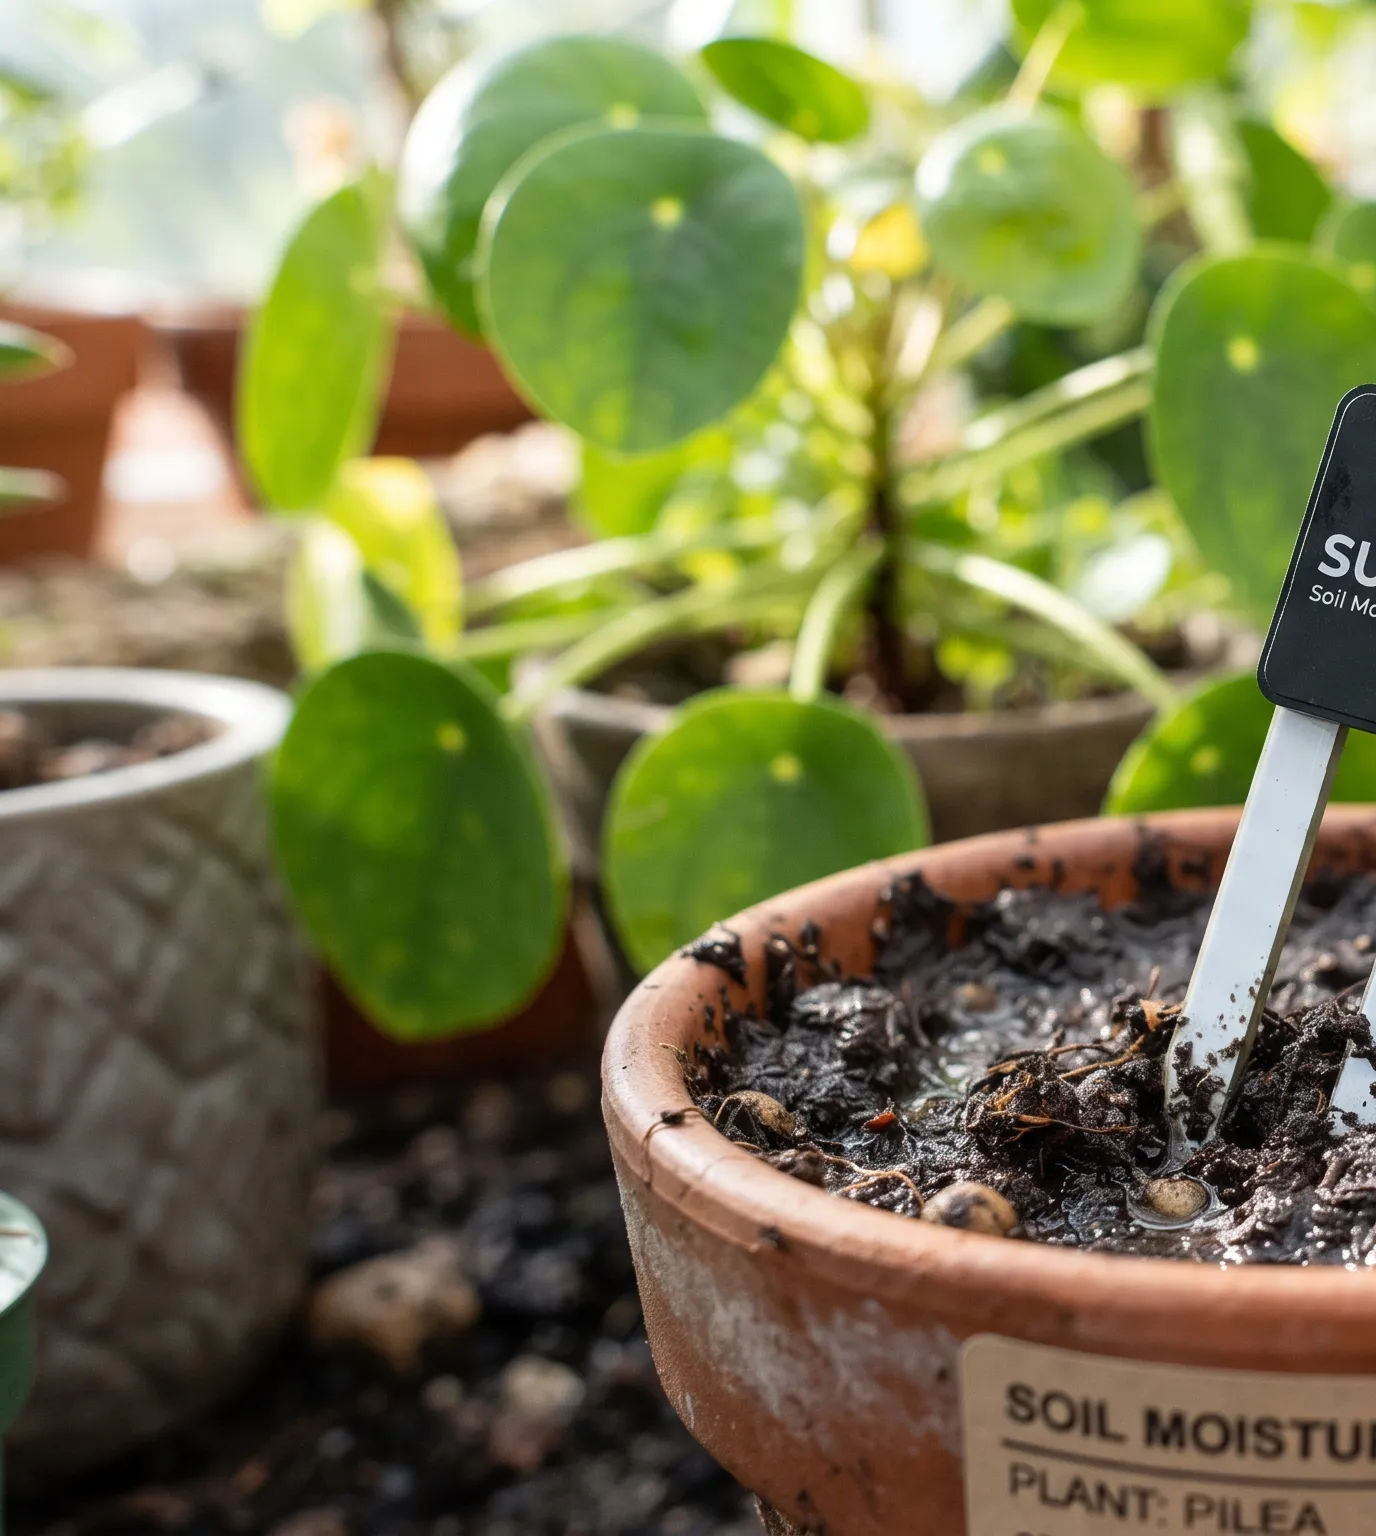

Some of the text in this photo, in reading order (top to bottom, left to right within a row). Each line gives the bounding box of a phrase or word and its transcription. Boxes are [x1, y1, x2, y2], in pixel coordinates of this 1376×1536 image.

[1308, 584, 1347, 609] Soil
[1004, 1381, 1128, 1444] SOIL
[1008, 1461, 1328, 1536] PLANT: PILEA
